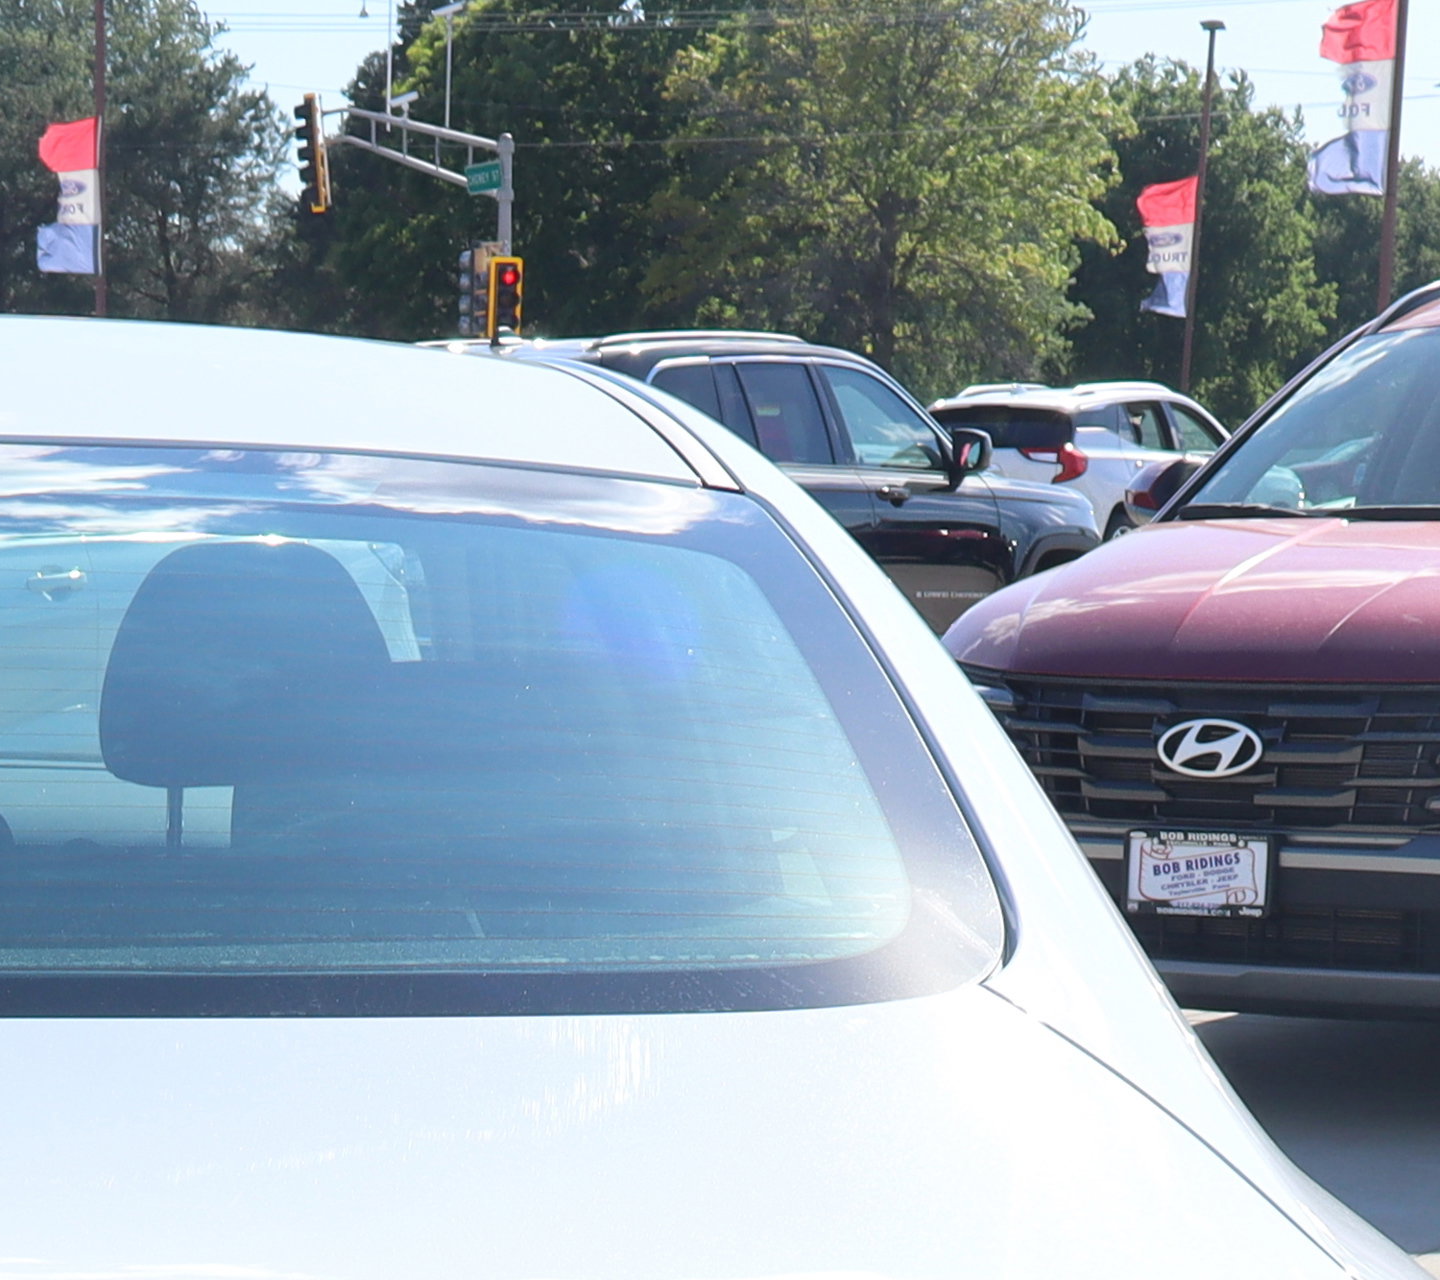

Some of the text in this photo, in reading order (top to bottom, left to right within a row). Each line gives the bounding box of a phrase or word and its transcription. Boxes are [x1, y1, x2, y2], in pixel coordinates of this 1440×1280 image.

[1159, 831, 1185, 841] BOB
[1187, 832, 1237, 843] RIDINGS
[1152, 852, 1241, 877] BOB RIDINGS
[1171, 872, 1196, 882] FORD
[1203, 867, 1235, 877] DODGE
[1161, 878, 1209, 891] CHRYSLER
[1216, 874, 1239, 883] JEEP
[1238, 906, 1263, 918] Jeep
